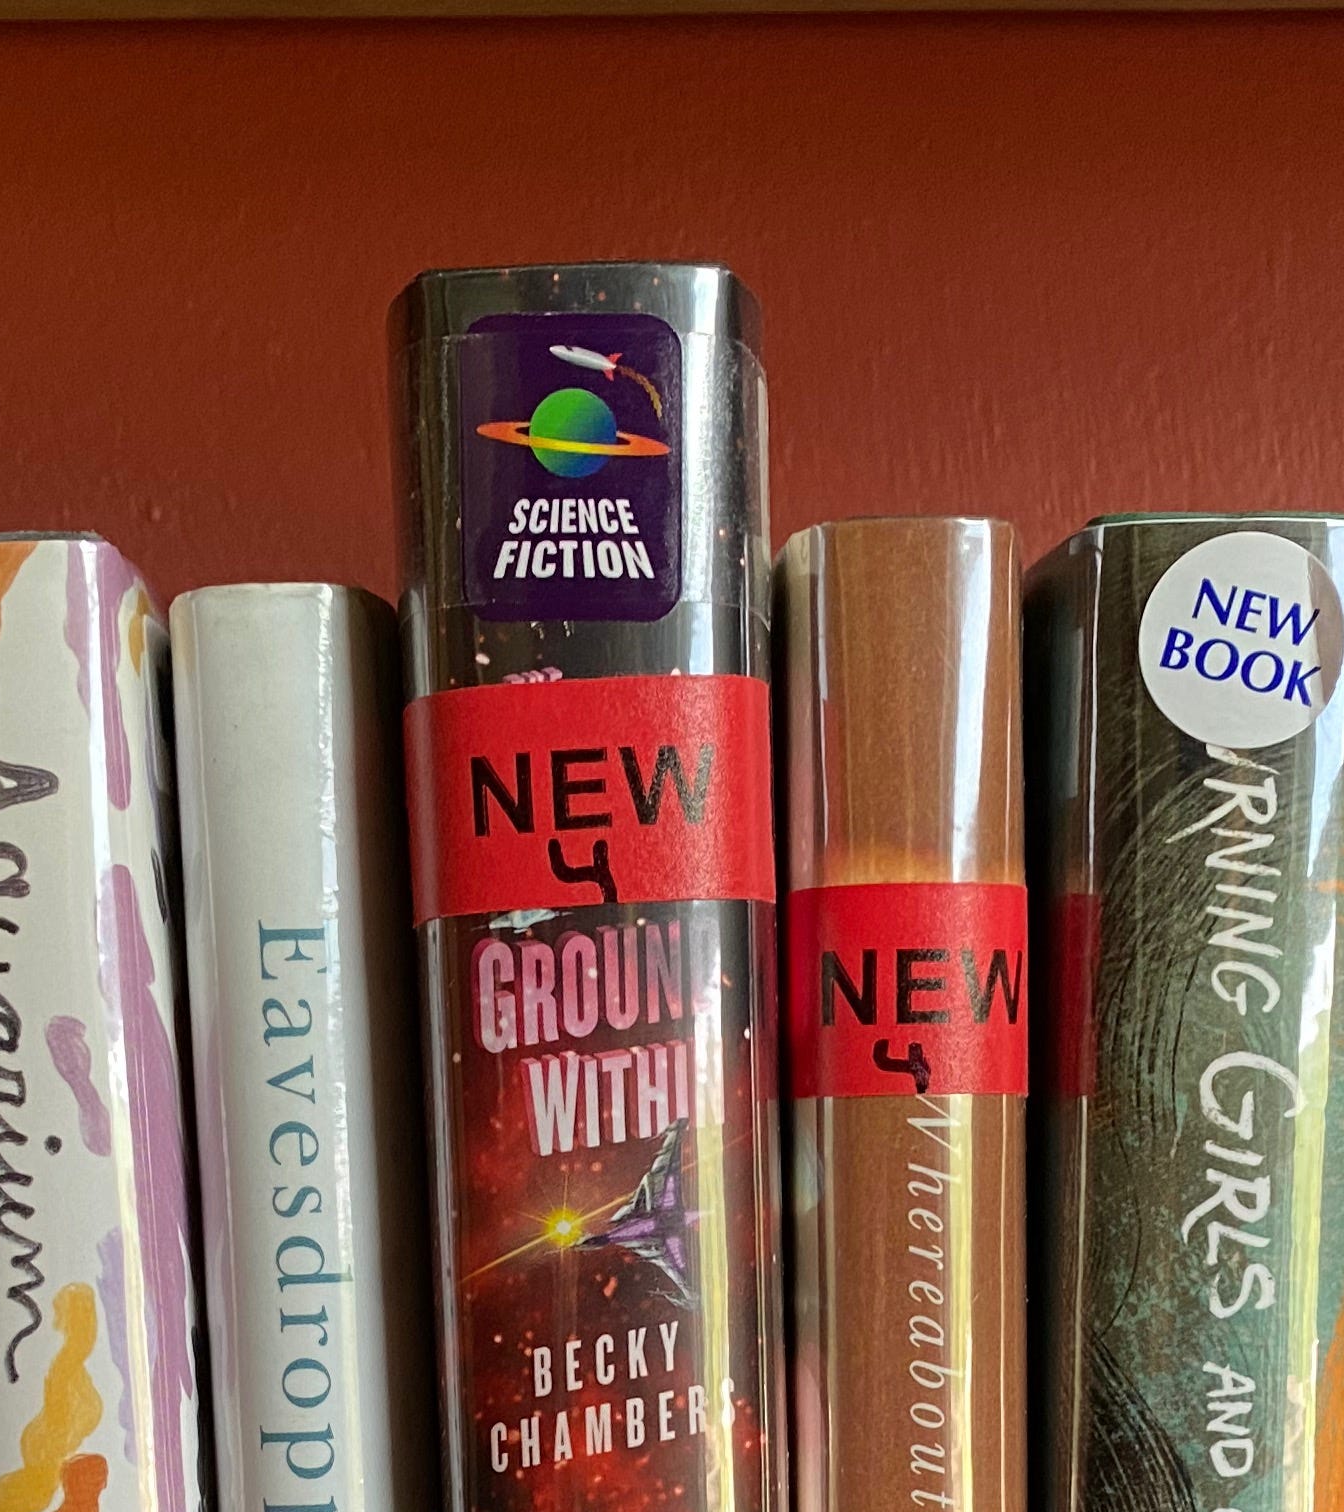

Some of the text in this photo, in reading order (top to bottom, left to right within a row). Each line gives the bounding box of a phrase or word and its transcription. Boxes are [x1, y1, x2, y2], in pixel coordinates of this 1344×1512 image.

[508, 497, 639, 535] SCIENCE
[493, 539, 655, 580] FICTION
[1192, 577, 1321, 648] NEW
[1159, 627, 1322, 708] BOOK
[470, 742, 715, 837] NEW
[821, 947, 1024, 1027] NEW
[533, 1320, 680, 1399] BECKY
[489, 1376, 736, 1474] CHAMBERS
[1201, 1360, 1254, 1479] AND
